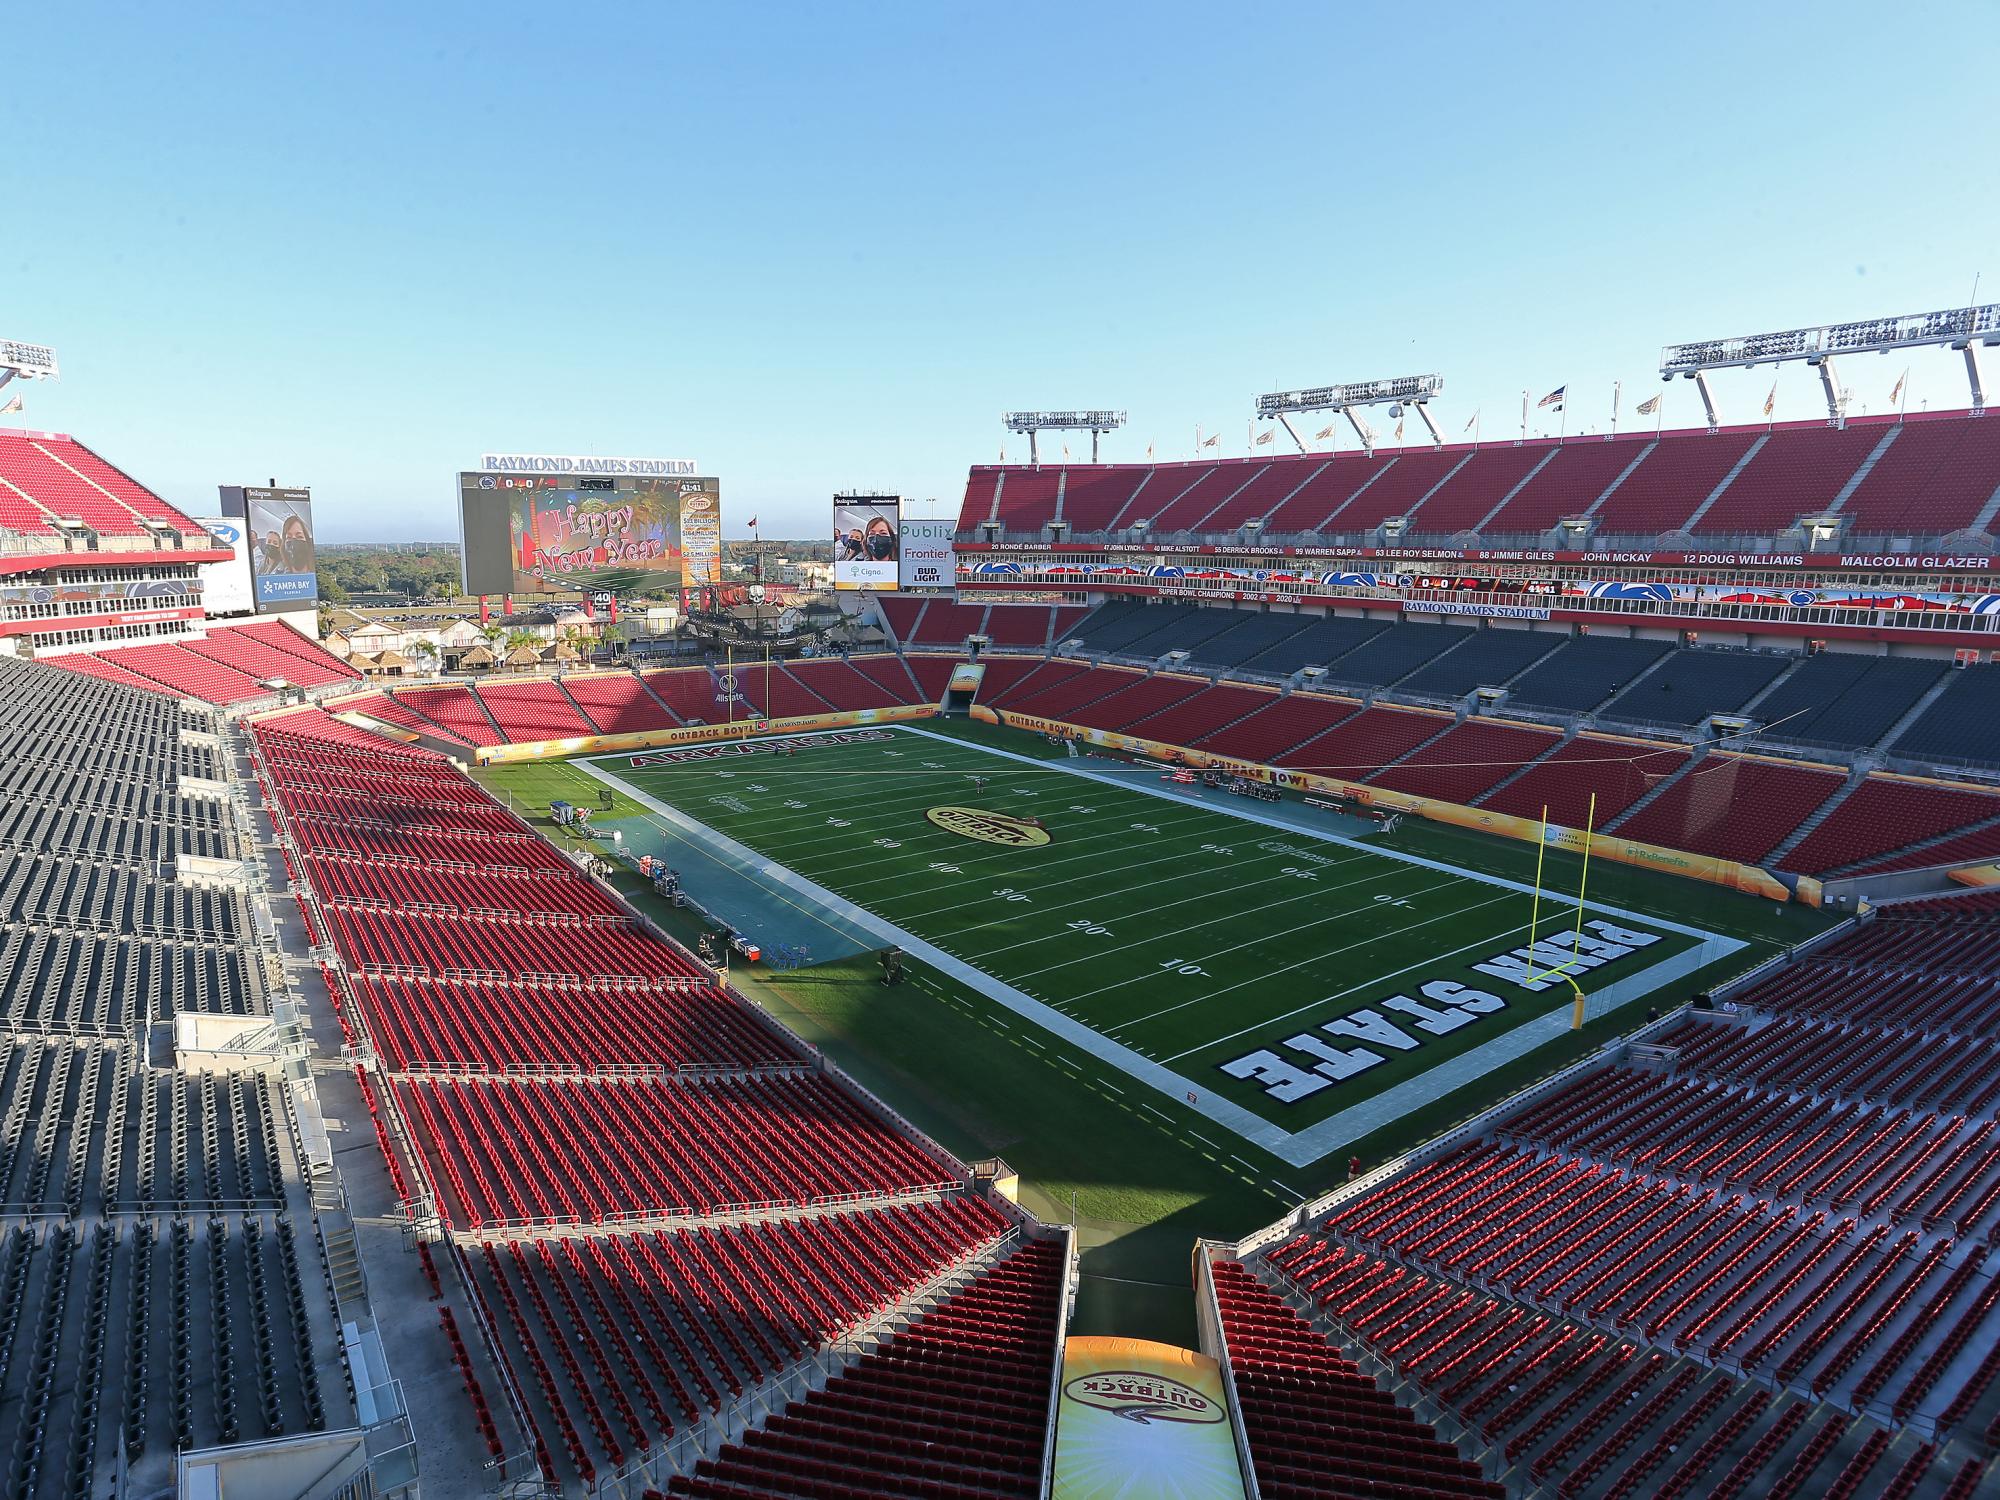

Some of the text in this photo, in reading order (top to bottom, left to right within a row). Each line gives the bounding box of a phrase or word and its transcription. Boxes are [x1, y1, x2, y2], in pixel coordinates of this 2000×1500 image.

[486, 456, 695, 474] RAYMOND JAMES STADIUM
[505, 479, 513, 488] 0
[526, 479, 533, 488] 0
[550, 504, 633, 542] Happy
[900, 526, 952, 538] Publix
[603, 538, 661, 567] Year
[905, 548, 949, 558] Frontier
[1422, 550, 1457, 558] SELMON
[1492, 552, 1523, 560] JIMMIE
[1526, 552, 1555, 560] GILES
[1581, 552, 1652, 562] JOHN MCKAY
[531, 544, 594, 577] New
[1683, 554, 1803, 566] 12 DOUG WILLIAMS
[1841, 556, 1990, 568] MALCOLM GLAZER
[861, 568, 881, 577] Cigna
[273, 580, 310, 590] TAMPA BAY
[1422, 579, 1429, 587] 0
[1440, 579, 1448, 588] 0
[1198, 590, 1235, 599] CHAMPIONS
[1528, 585, 1556, 594] 41:41
[595, 593, 609, 602] 40
[1405, 601, 1548, 619] RAYMOND JAMES STADIUM
[715, 693, 744, 702] Allsate
[1010, 716, 1074, 736] OUTBACK BOWL
[671, 728, 719, 740] OUTBACK
[630, 731, 895, 768] ARKANSAS
[1210, 758, 1264, 778] OUTBACK
[936, 811, 1028, 843] OUTBACK
[873, 838, 901, 849] 50
[1558, 838, 1591, 847] CLEARWATR
[1640, 851, 1689, 868] RxBenefits
[928, 862, 959, 872] 40
[1280, 867, 1318, 878] 20
[992, 888, 1027, 901] 30
[1374, 895, 1410, 906] 10
[1066, 919, 1106, 934] 20
[1470, 918, 1665, 993] PENN
[1159, 958, 1201, 975] 10
[1215, 979, 1511, 1104] STATE
[1096, 1377, 1189, 1395] BOWL
[1083, 1382, 1208, 1409] OUTBACK
